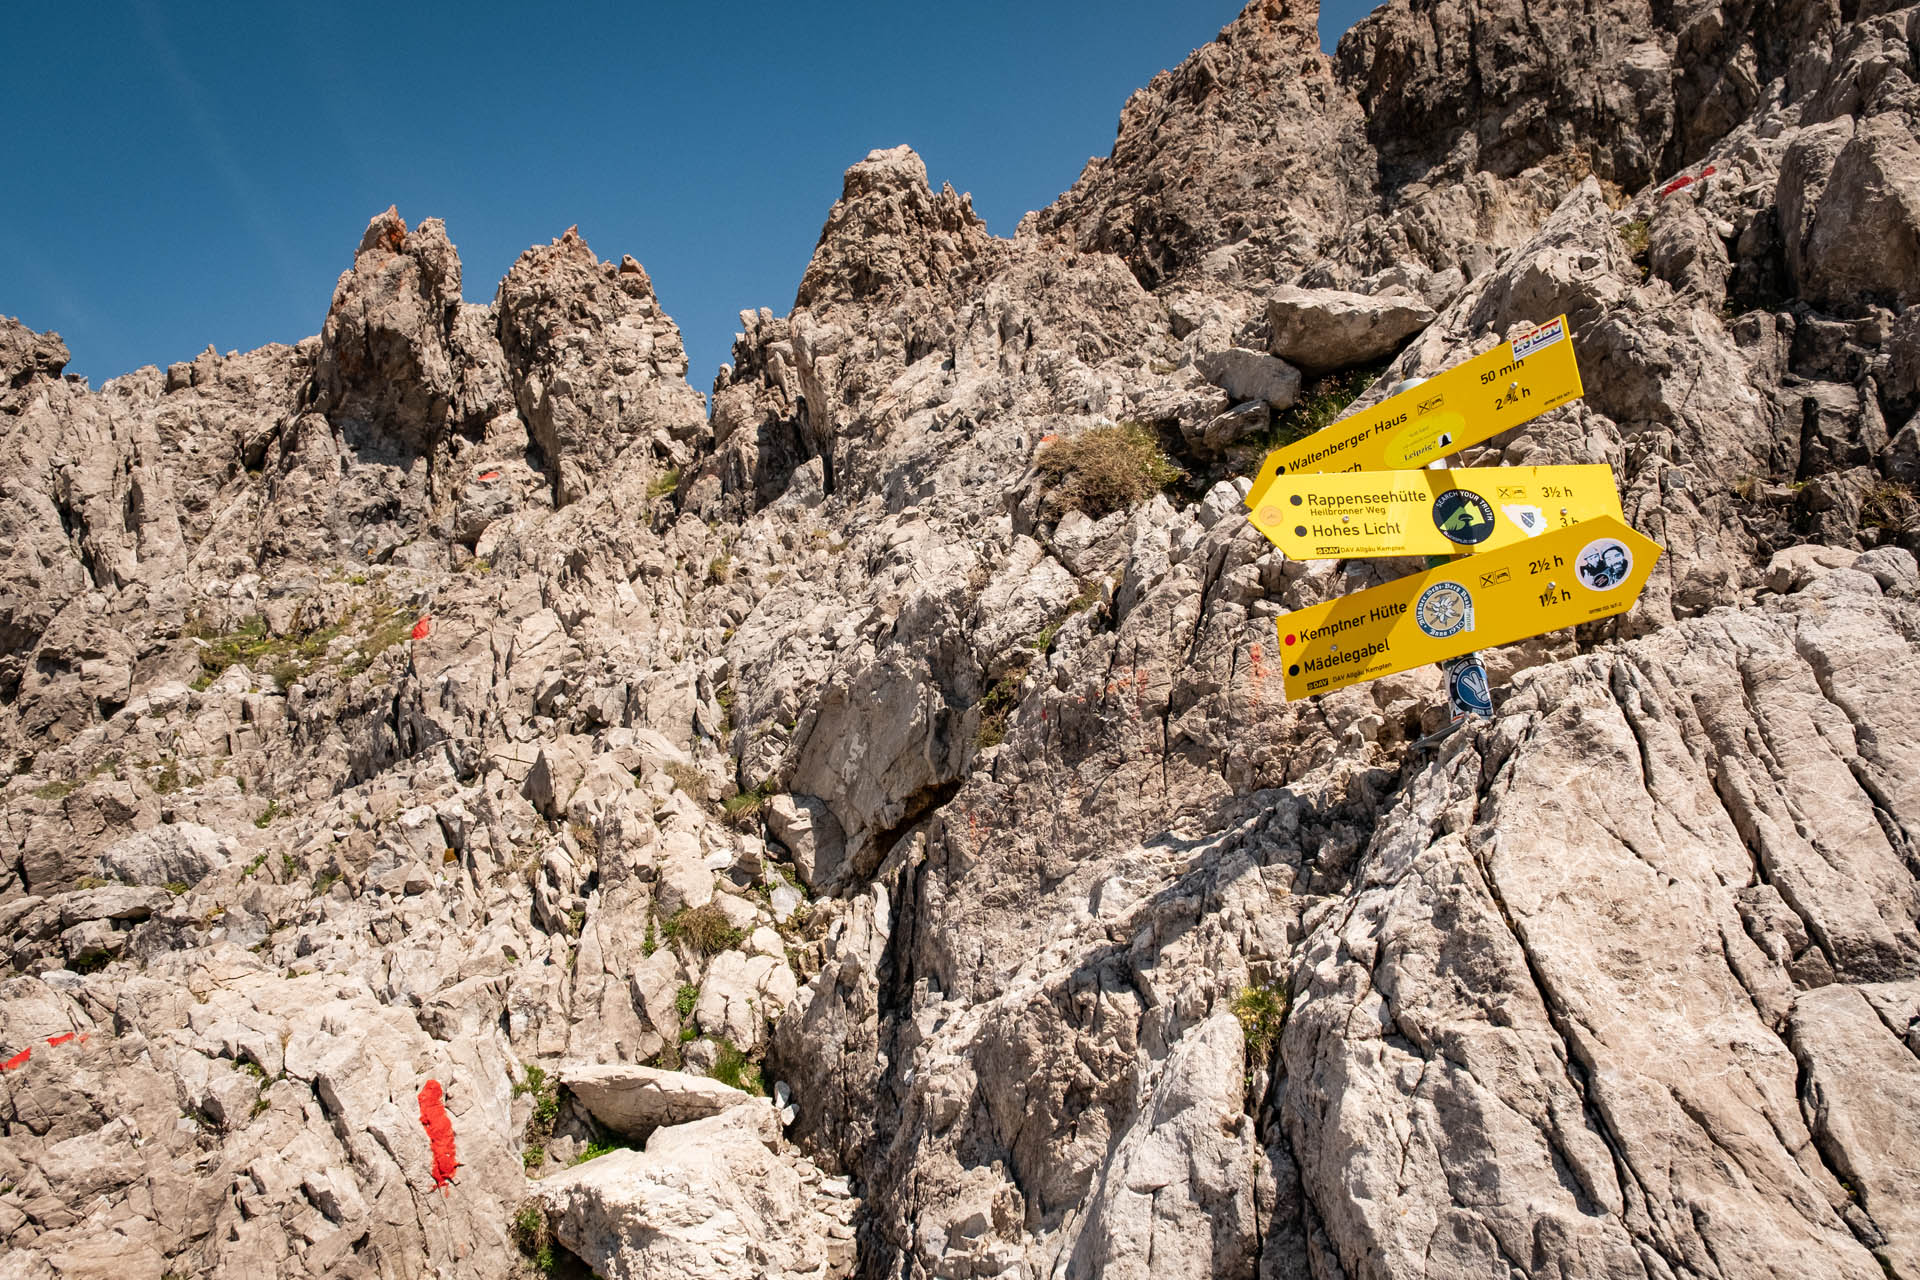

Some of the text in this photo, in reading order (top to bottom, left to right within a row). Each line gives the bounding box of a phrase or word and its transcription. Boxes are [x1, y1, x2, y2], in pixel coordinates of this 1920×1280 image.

[1480, 359, 1525, 385] 50 min
[1521, 387, 1531, 398] h
[1288, 428, 1372, 472] Waltenberger
[1374, 412, 1408, 435] Haus
[1308, 491, 1427, 508] Rappenseehütte
[1564, 486, 1573, 497] h
[1310, 506, 1386, 516] Heilbronner Weg
[1435, 490, 1494, 521] SEARCH YOUR TRUTH
[1312, 522, 1401, 537] Hohes Licht
[1553, 555, 1564, 567] h
[1561, 589, 1571, 601] h
[1300, 602, 1407, 643] Kemptner Hütte
[1304, 638, 1391, 674] Mädelegabel
